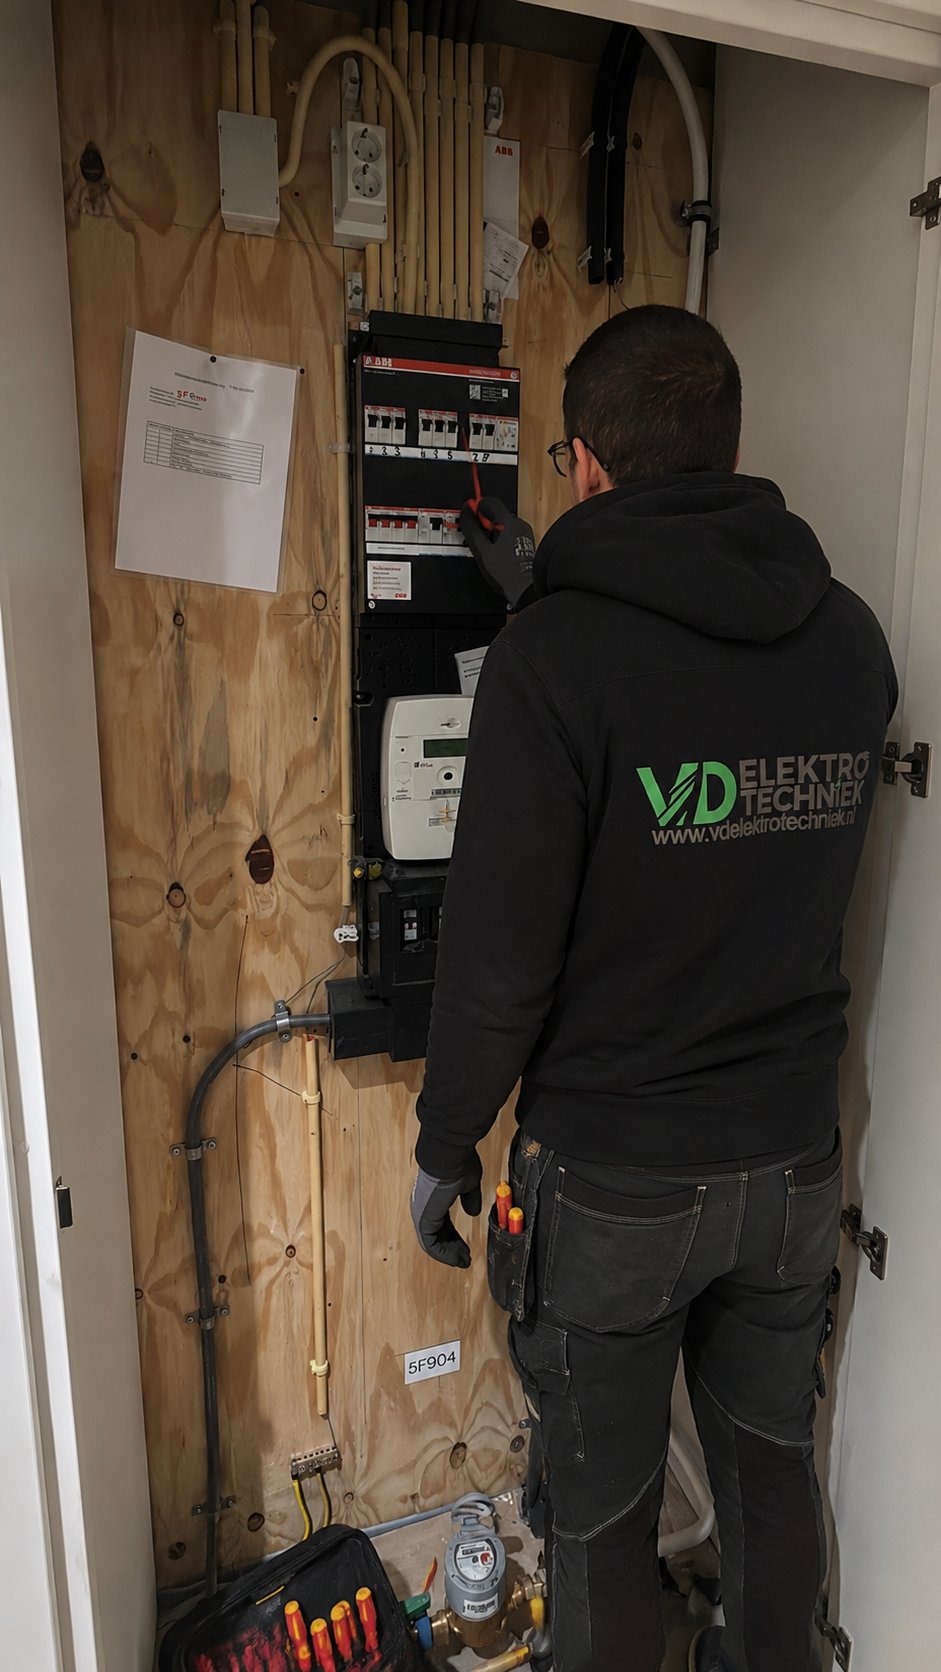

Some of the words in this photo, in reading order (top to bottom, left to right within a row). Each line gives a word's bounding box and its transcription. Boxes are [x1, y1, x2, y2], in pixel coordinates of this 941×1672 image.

[495, 145, 513, 156] ABB
[739, 751, 870, 789] ELEKTRO
[636, 761, 737, 826] VD
[740, 780, 864, 815] TECHNIEK
[652, 806, 857, 845] www.vdelektrotechniek.nl
[408, 1351, 456, 1374] 5F904
